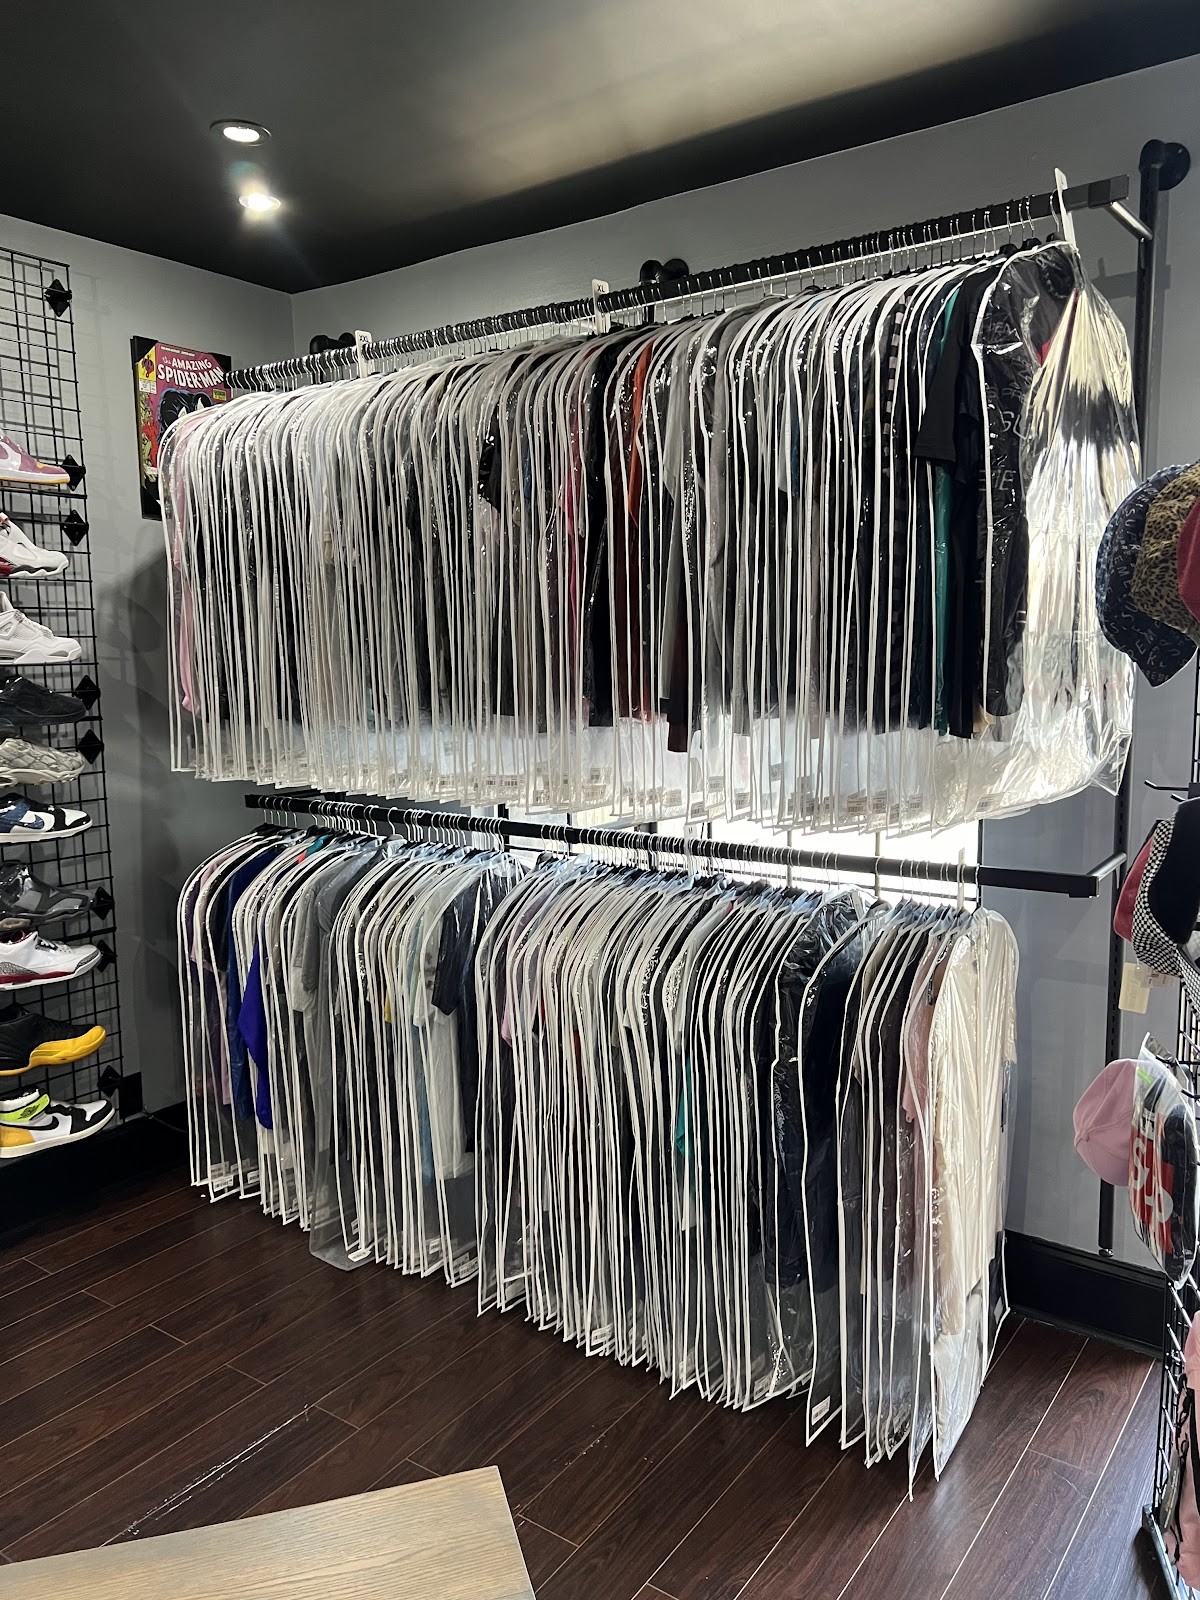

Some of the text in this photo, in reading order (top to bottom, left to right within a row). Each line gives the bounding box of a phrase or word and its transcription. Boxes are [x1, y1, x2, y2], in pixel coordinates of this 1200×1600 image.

[596, 284, 605, 293] XL
[172, 358, 212, 370] AMAZING
[157, 364, 224, 388] SPIDER-MAN
